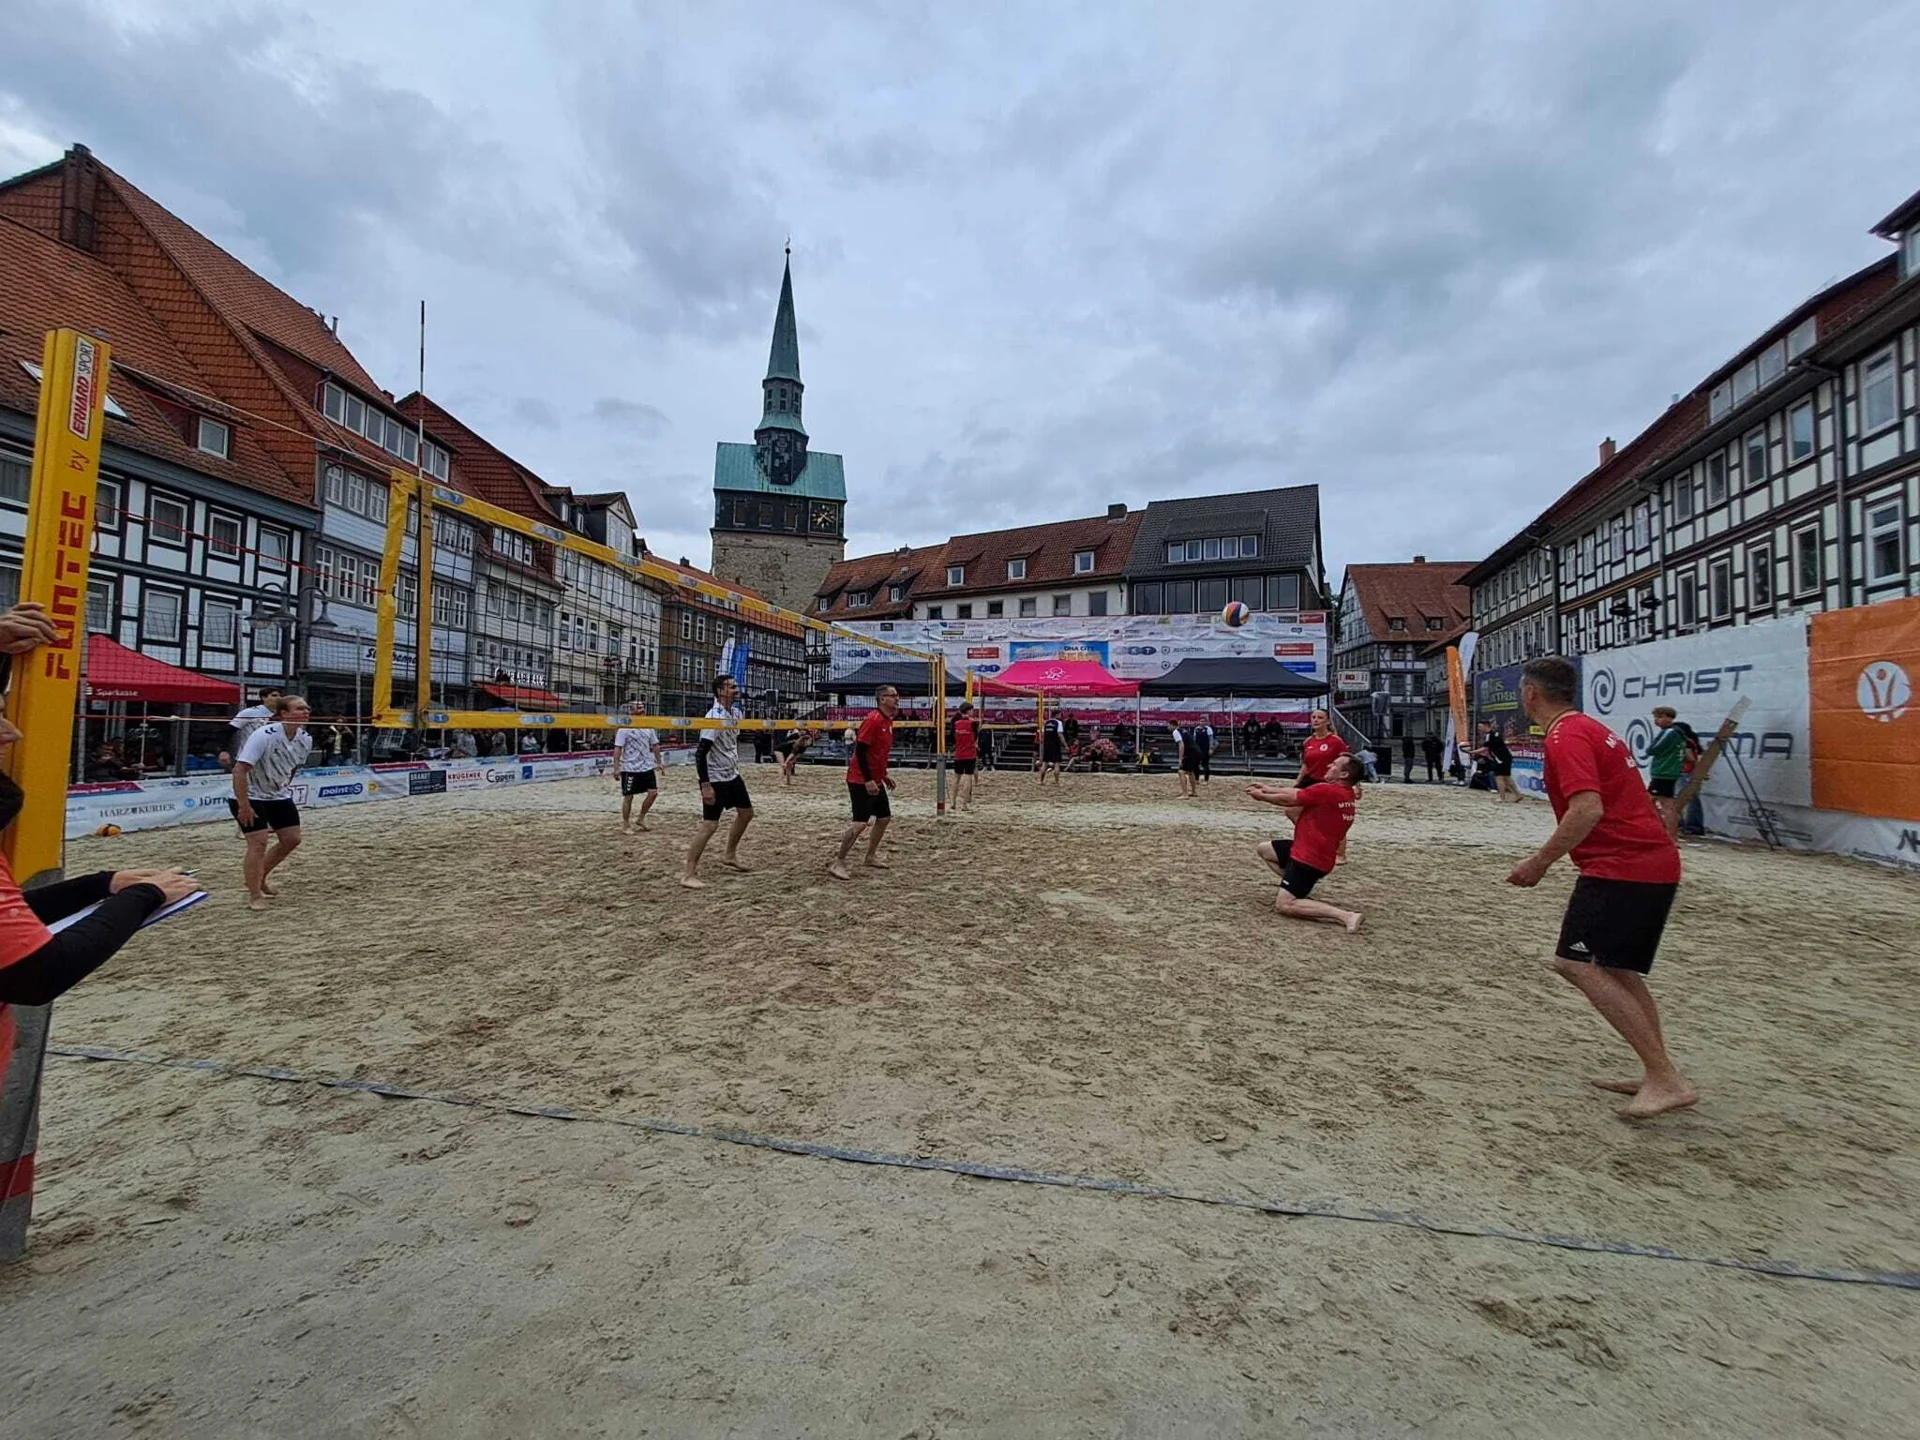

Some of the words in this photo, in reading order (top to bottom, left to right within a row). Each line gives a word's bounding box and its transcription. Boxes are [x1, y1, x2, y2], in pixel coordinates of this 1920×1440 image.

[79, 343, 92, 374] SPORT
[73, 376, 89, 434] ERHARD
[68, 449, 90, 472] by
[1623, 664, 1753, 698] CHRIST
[322, 787, 348, 795] point
[100, 807, 132, 818] HARZ
[138, 803, 176, 815] KURIER
